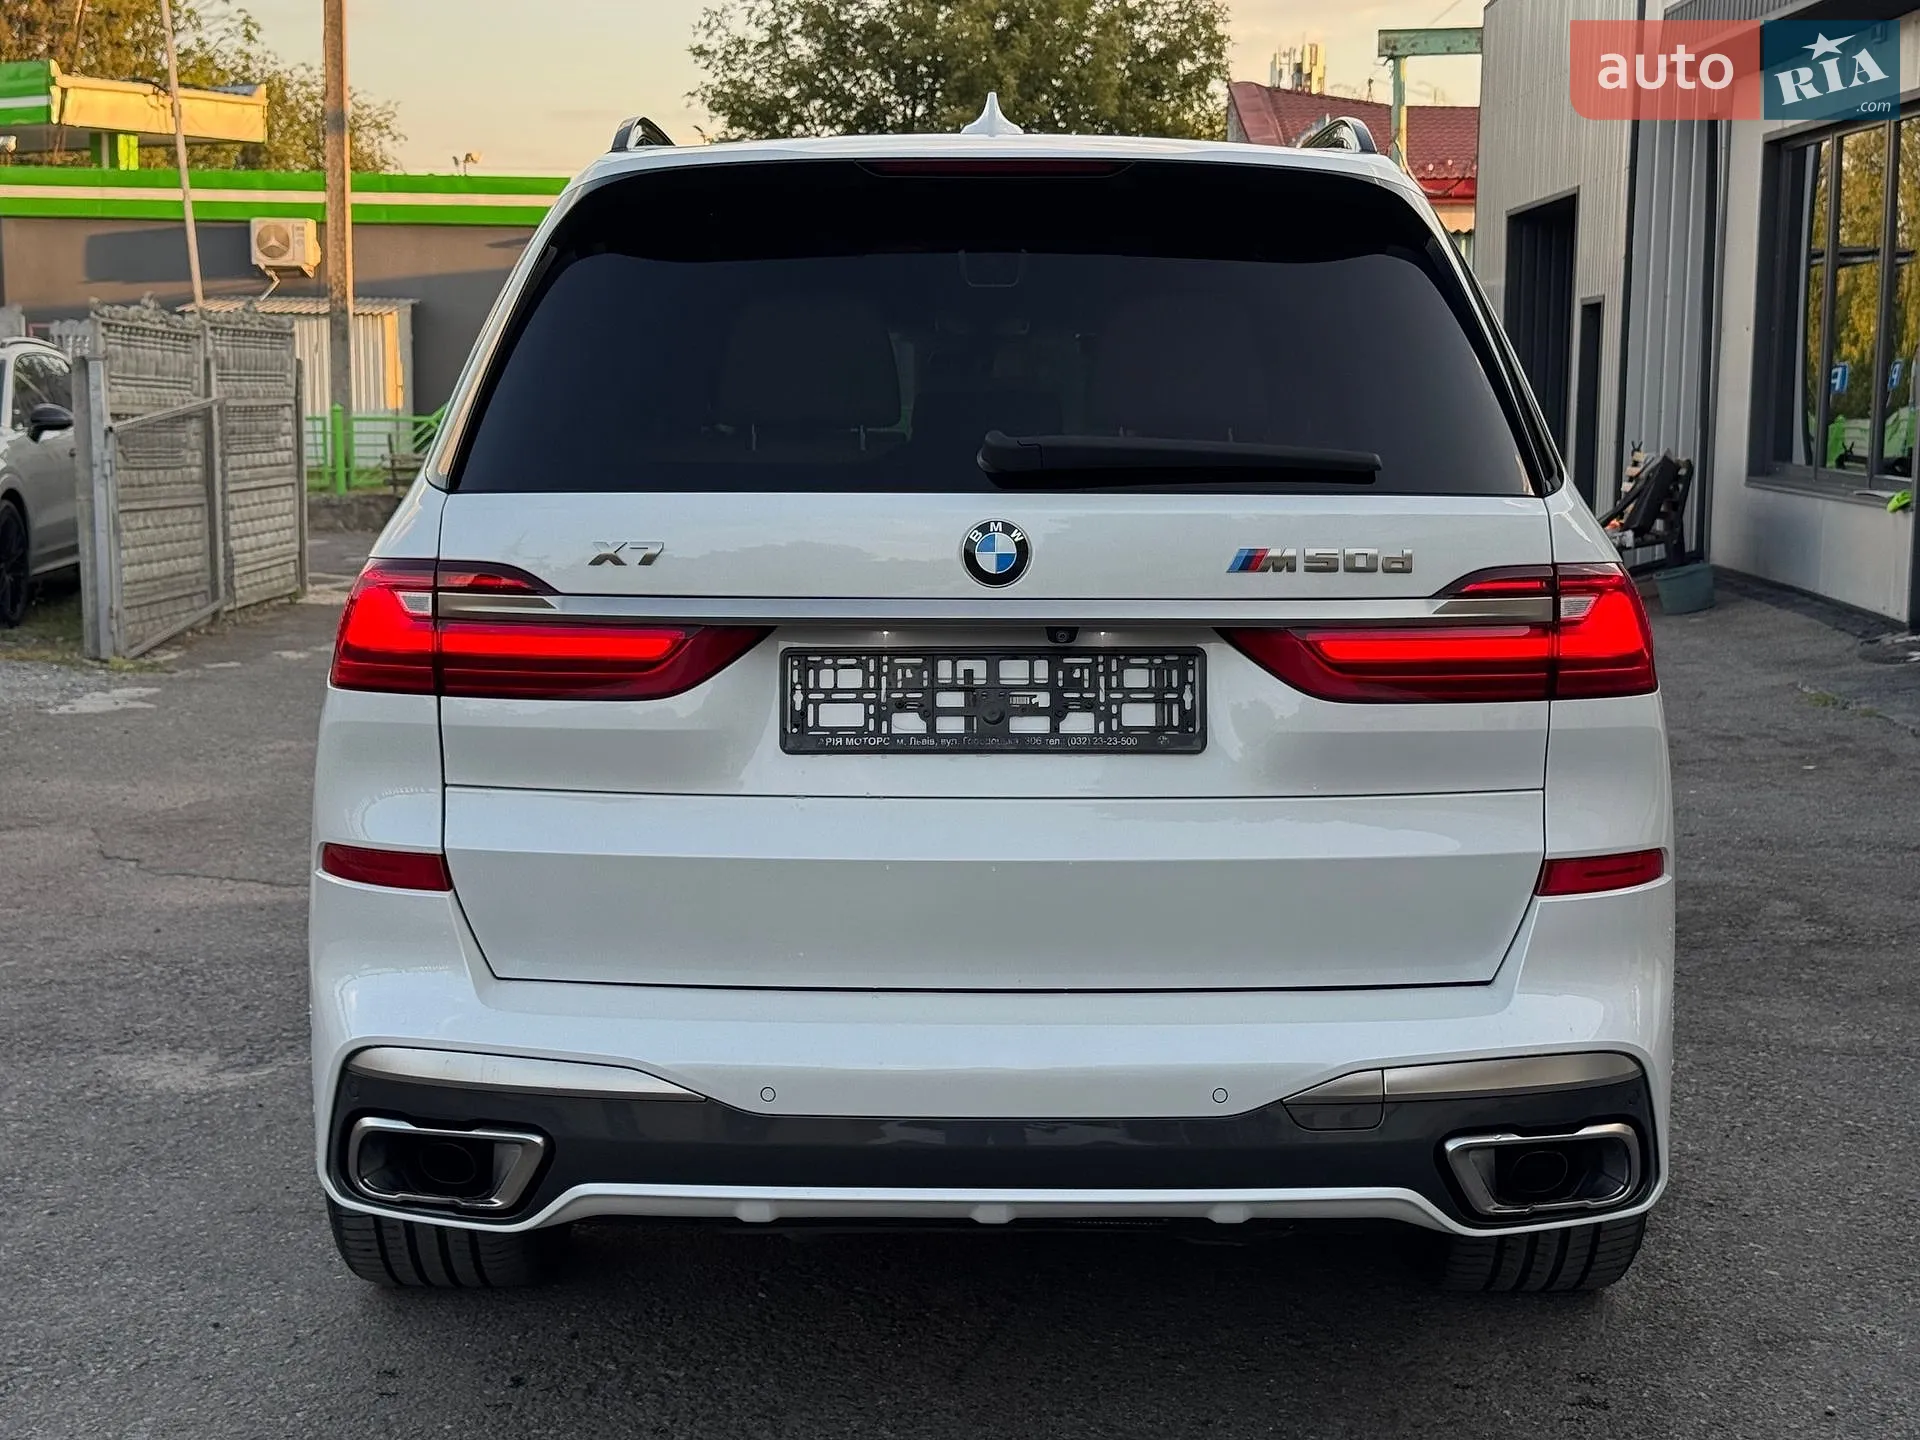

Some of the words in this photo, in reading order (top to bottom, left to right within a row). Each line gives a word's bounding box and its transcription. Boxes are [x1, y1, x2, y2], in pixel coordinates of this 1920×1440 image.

[969, 521, 1025, 543] BMW
[588, 541, 664, 566] X7
[1228, 547, 1412, 573] M50d
[845, 736, 890, 746] МОТОРС
[1093, 736, 1138, 746] 23-23-500
